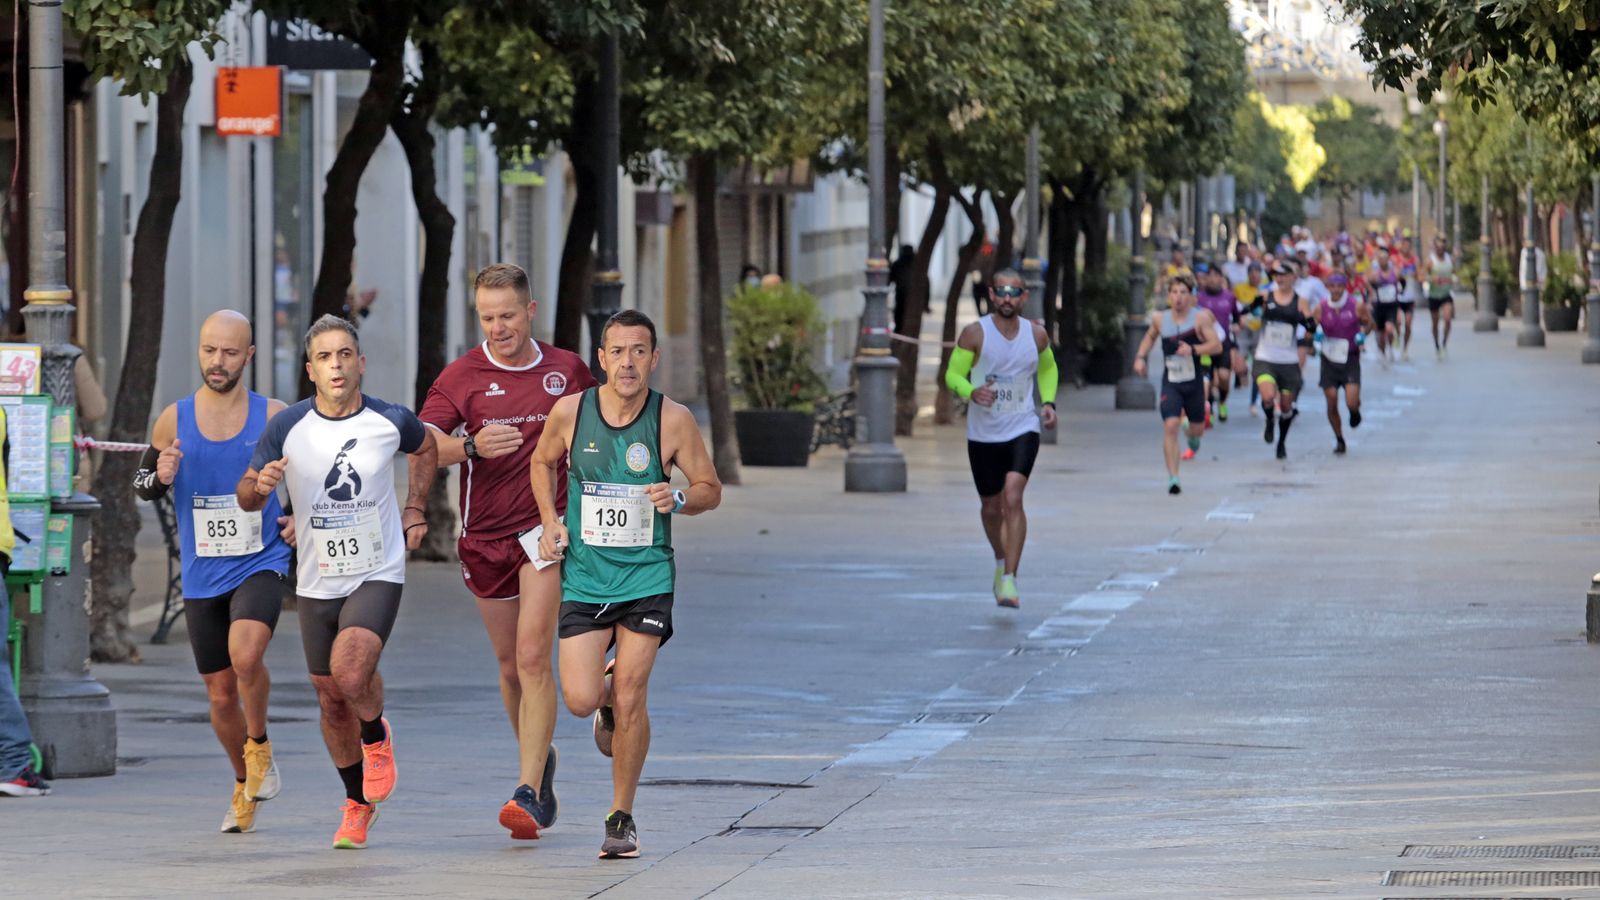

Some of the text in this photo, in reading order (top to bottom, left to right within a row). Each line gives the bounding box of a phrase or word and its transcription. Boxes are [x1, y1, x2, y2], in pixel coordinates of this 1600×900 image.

[217, 116, 274, 135] orange
[482, 413, 548, 426] Delegación de De
[331, 502, 355, 510] Kema
[357, 499, 376, 508] Kilos
[595, 507, 628, 528] 130
[207, 519, 238, 538] 853
[327, 537, 359, 558] 813
